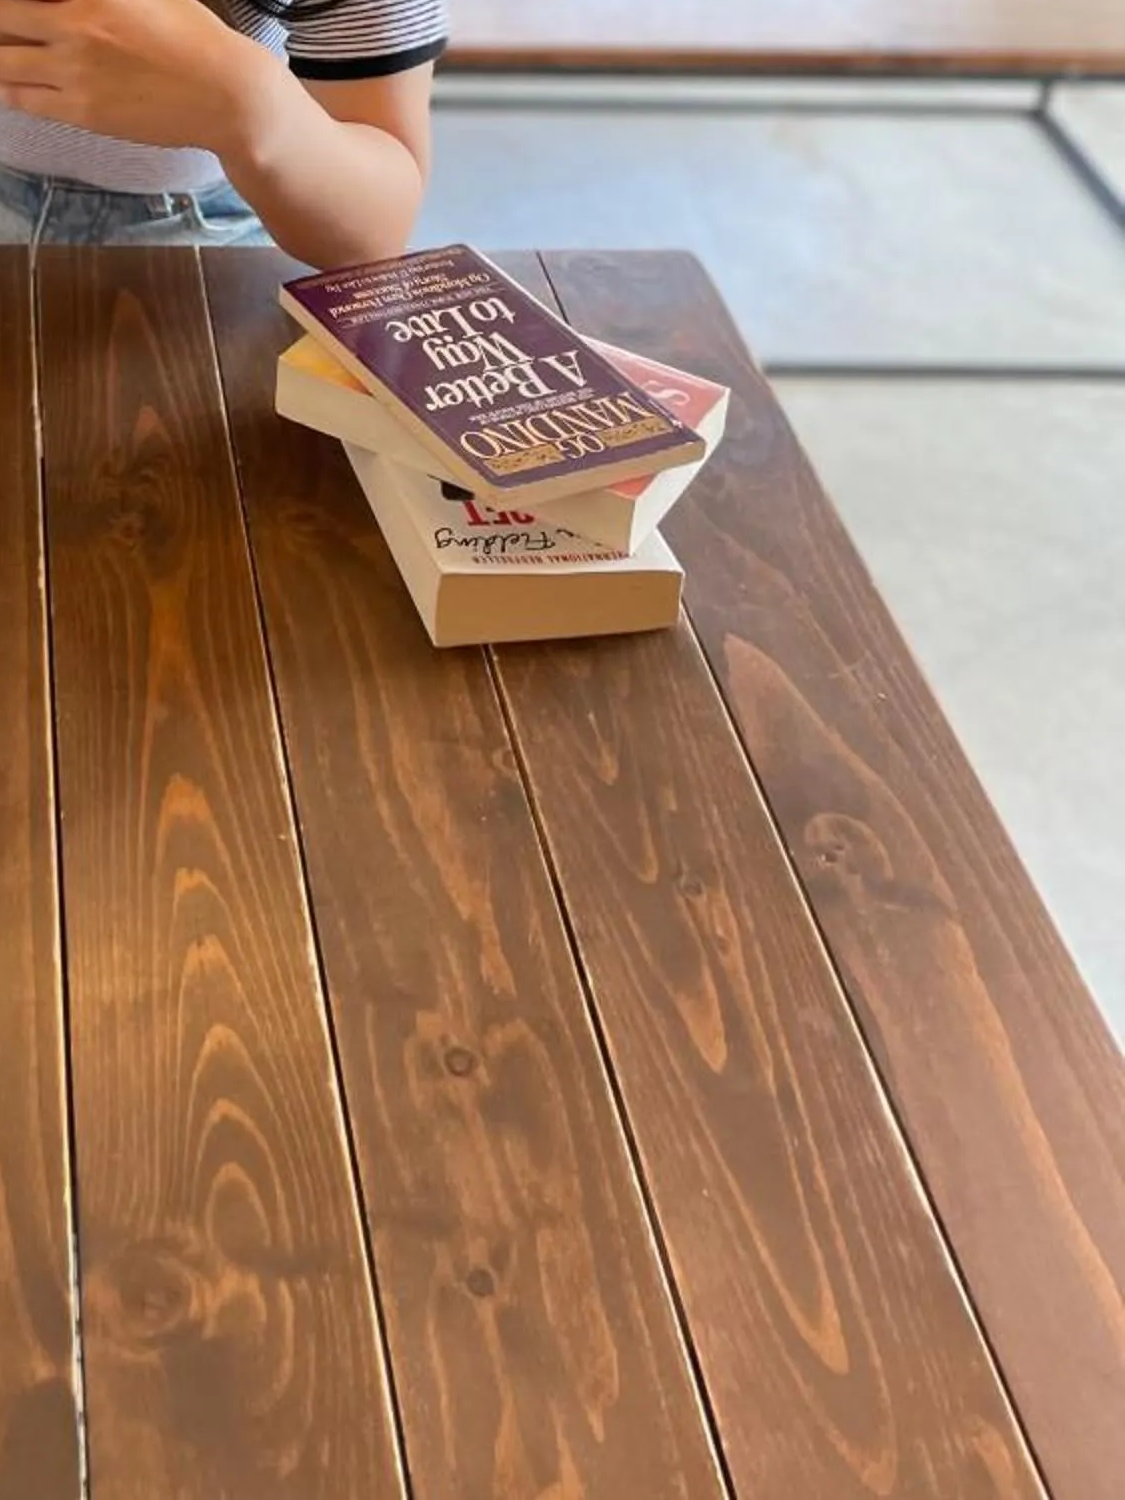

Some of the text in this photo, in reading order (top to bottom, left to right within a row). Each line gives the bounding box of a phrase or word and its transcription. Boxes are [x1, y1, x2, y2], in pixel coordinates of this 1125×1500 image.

[384, 305, 484, 345] Live
[468, 296, 516, 325] to
[422, 331, 535, 371] Way
[537, 350, 587, 387] A
[424, 362, 556, 412] Better
[459, 391, 654, 459] MANDINO
[554, 432, 606, 459] OG
[434, 528, 556, 555] Fielding
